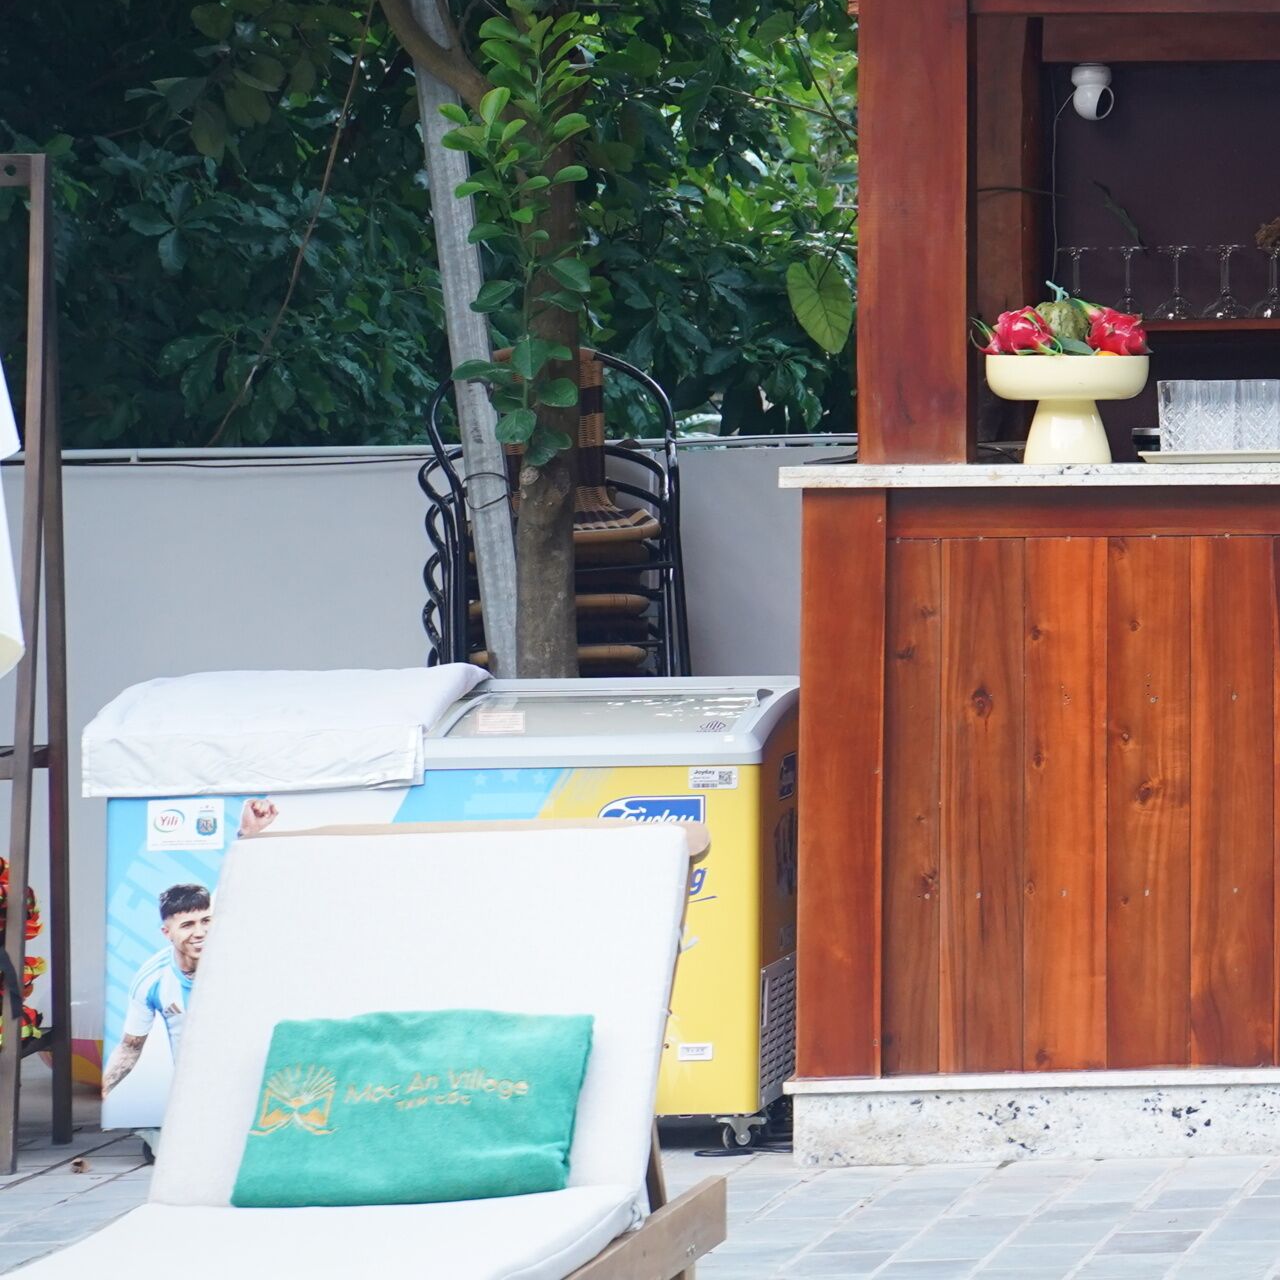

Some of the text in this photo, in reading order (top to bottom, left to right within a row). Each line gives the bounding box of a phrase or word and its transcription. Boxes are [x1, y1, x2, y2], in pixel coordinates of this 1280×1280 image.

[160, 816, 178, 827] Yili
[406, 1072, 439, 1094] An
[447, 1068, 530, 1100] Village
